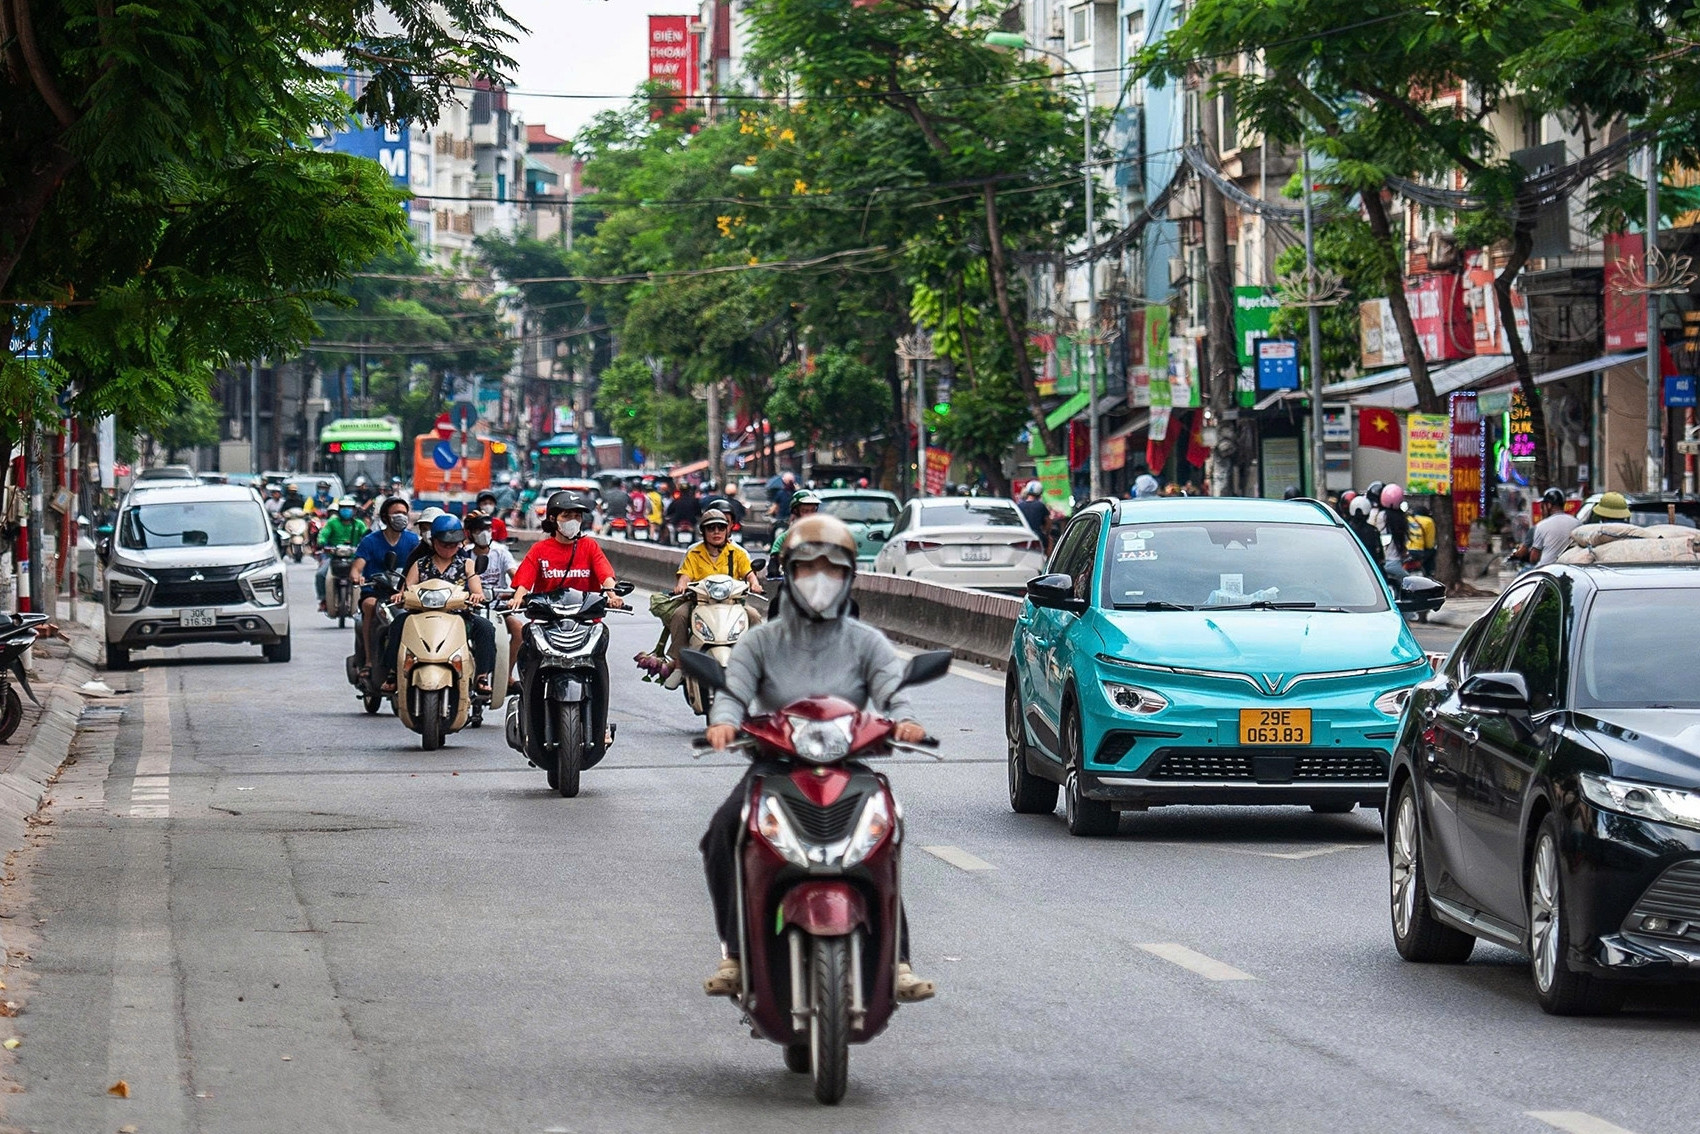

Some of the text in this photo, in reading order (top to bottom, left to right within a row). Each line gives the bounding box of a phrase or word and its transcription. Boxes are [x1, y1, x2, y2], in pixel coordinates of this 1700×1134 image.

[1120, 549, 1156, 560] TAXI
[542, 566, 592, 580] ietnames
[190, 608, 206, 618] 30K
[1259, 710, 1292, 727] 29E
[1246, 727, 1305, 744] 063.83
